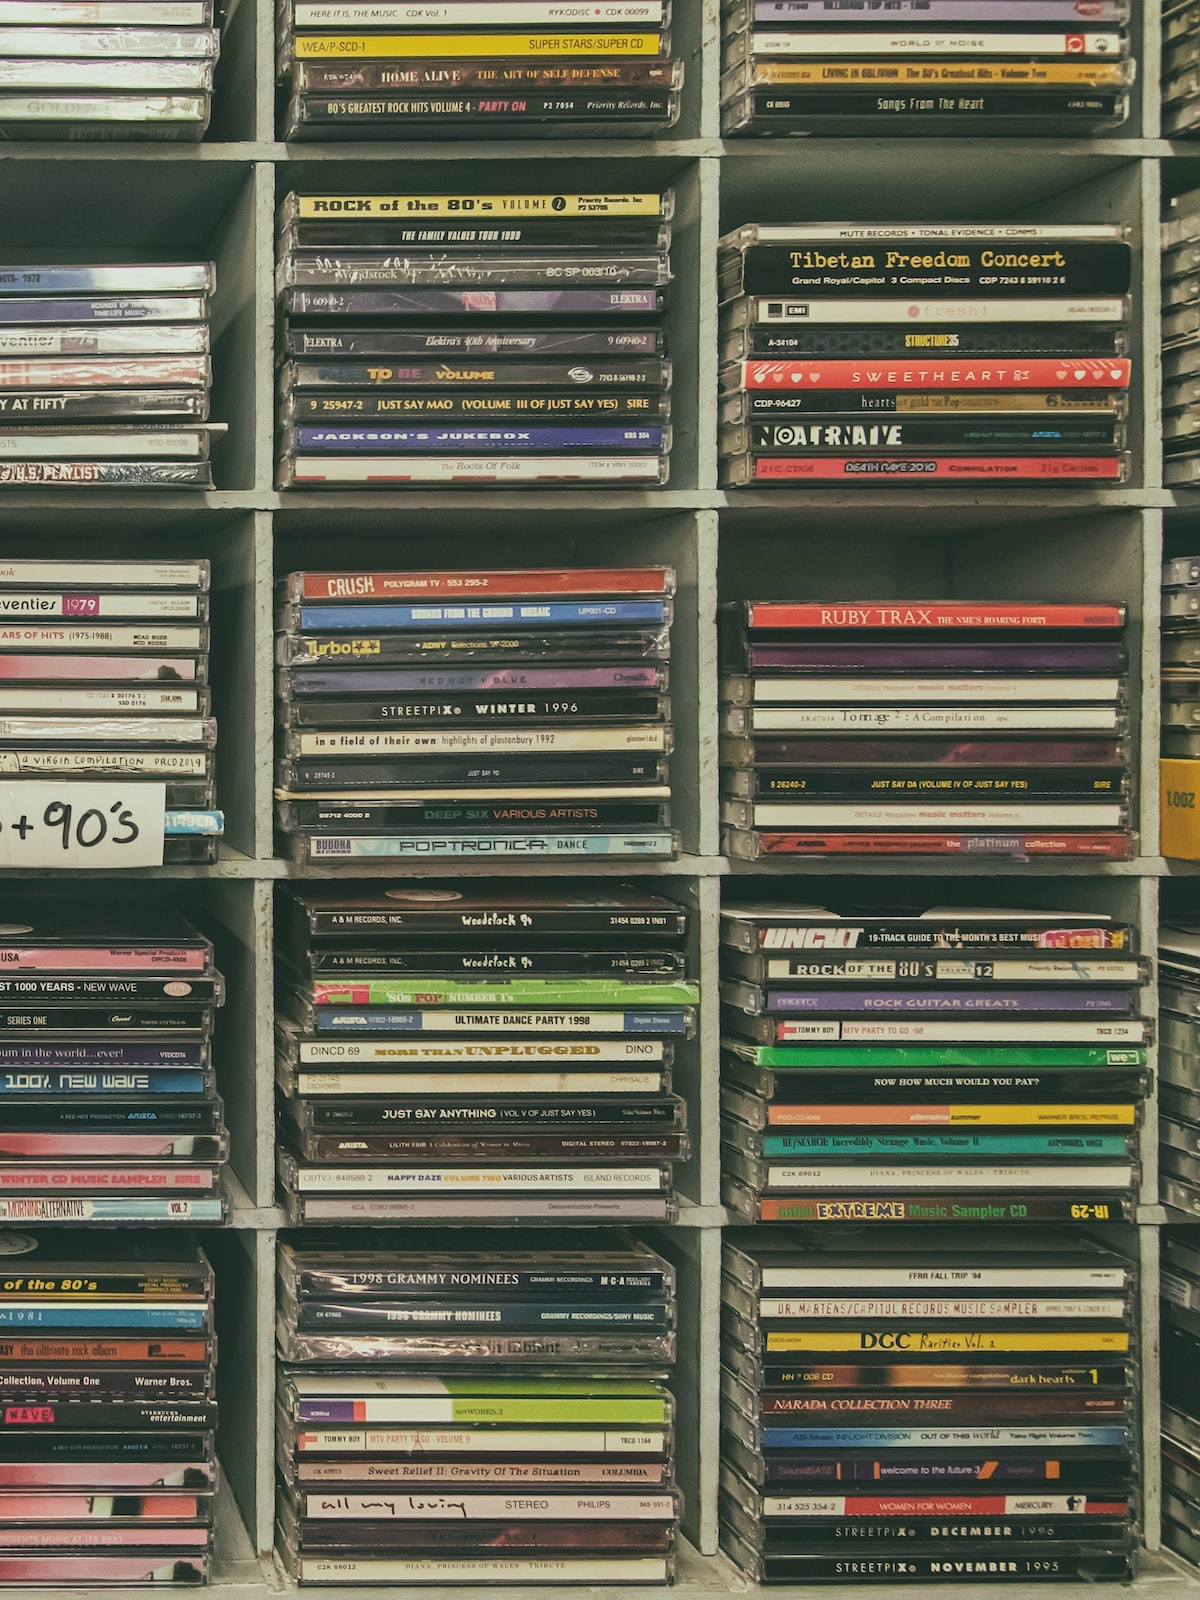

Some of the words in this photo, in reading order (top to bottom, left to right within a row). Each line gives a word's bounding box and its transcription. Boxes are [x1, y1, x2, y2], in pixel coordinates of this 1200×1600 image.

[303, 42, 365, 52] WEA/P-SCD-1
[529, 39, 560, 49] SUPER
[562, 39, 628, 49] STARS/SUPER
[631, 38, 643, 48] CD
[878, 98, 905, 111] Songs
[910, 98, 934, 109] From
[939, 98, 954, 109] The
[959, 99, 984, 109] Heart
[790, 252, 875, 268] Tibetan
[885, 252, 970, 268] Freedom
[981, 251, 1065, 267] Concert
[853, 371, 1007, 383] SWEETHEART
[12, 399, 29, 410] AT
[33, 397, 70, 410] FIFTY
[328, 576, 377, 597] CRUSH
[67, 599, 95, 610] 1979
[821, 608, 870, 627] RUBY
[876, 608, 932, 627] TRAX
[475, 704, 536, 714] WINTER
[545, 703, 577, 712] 1996
[11, 815, 34, 840] +
[15, 983, 37, 991] 1000
[40, 983, 74, 991] YEARS
[84, 982, 106, 991] NEW
[109, 982, 138, 991] WAVE
[456, 1016, 500, 1024] ULTIMATE
[503, 1016, 532, 1024] DANCE
[536, 1016, 565, 1024] PARTY
[569, 1016, 590, 1024] 1998
[311, 1047, 344, 1055] DINCD
[348, 1047, 360, 1055] 69
[626, 1045, 653, 1053] DINO
[353, 1273, 383, 1284] 1998
[387, 1273, 447, 1285] GRAMMY
[451, 1272, 520, 1285] NOMINEES
[3, 1280, 23, 1289] of
[27, 1280, 55, 1290] the
[860, 1333, 912, 1350] DGC
[47, 1376, 81, 1385] Volume
[83, 1377, 100, 1385] One
[134, 1377, 167, 1386] Warner
[169, 1377, 192, 1386] Bros.
[505, 1500, 548, 1509] STEREO
[931, 1562, 1017, 1572] NOVEMBER
